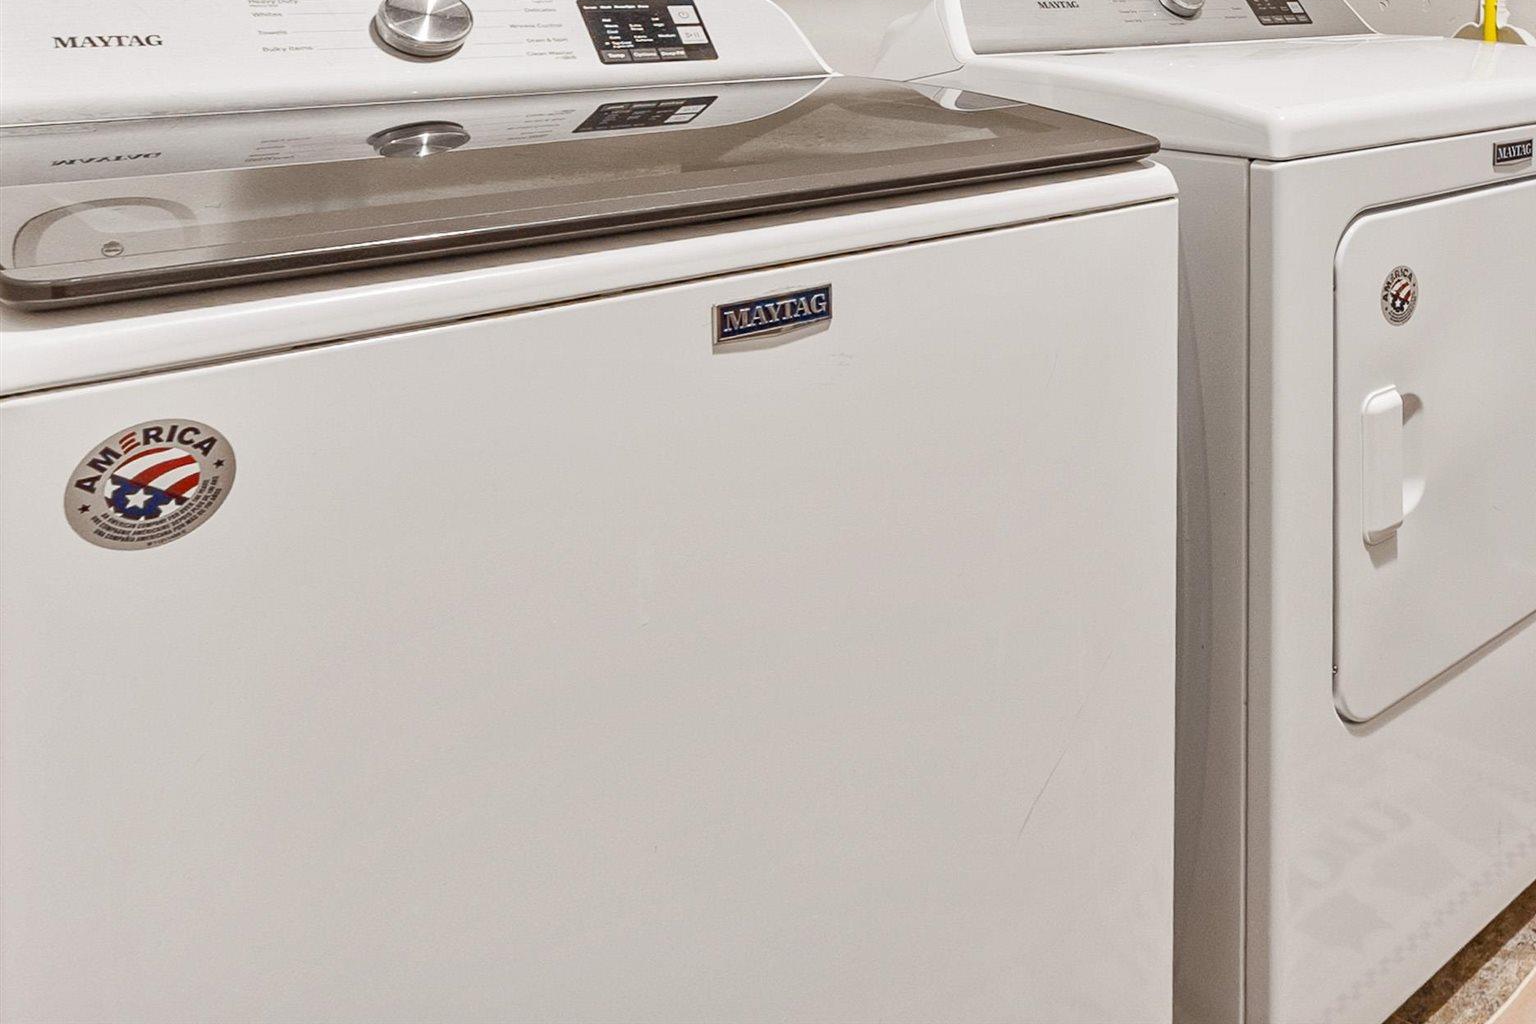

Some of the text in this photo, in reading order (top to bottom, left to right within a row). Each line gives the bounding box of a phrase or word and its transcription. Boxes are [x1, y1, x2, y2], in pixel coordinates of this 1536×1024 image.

[52, 34, 163, 49] MAYTAG
[1496, 142, 1532, 160] MAYTAG
[723, 293, 827, 332] MAYTAG
[75, 425, 217, 494] AMERICA
